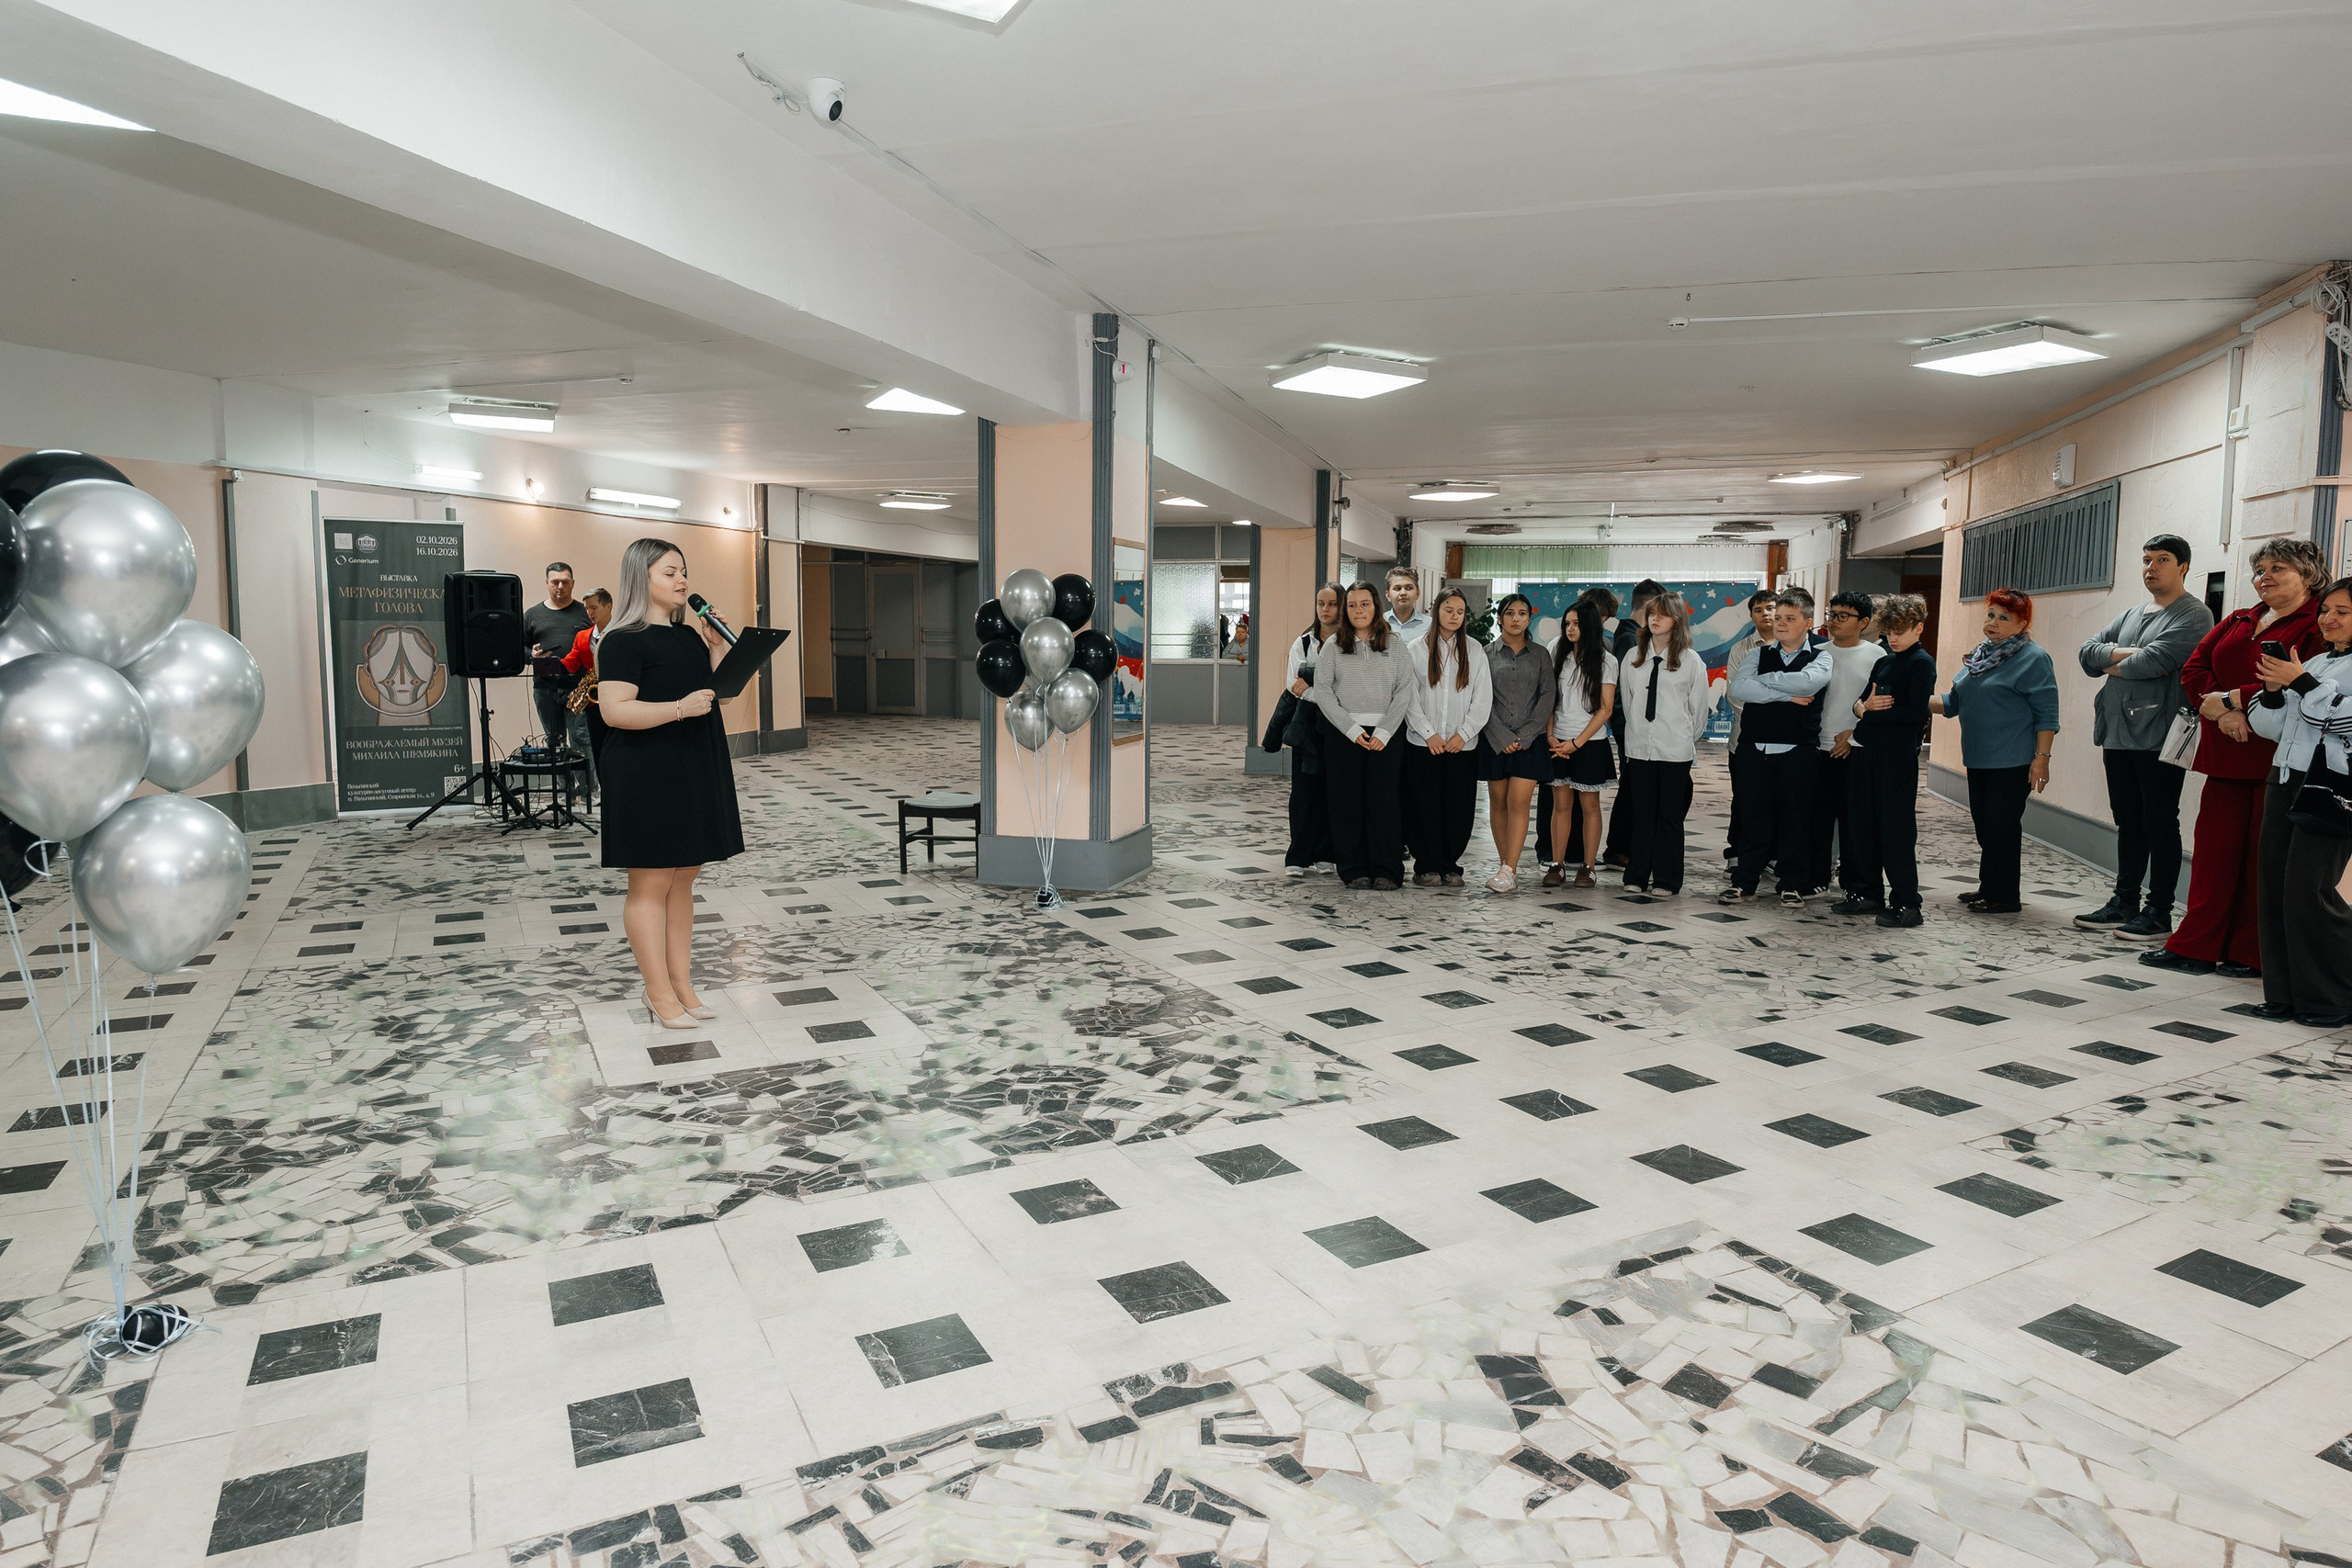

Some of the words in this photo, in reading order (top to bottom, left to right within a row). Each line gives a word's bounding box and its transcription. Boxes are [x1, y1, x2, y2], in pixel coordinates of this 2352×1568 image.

[416, 536, 458, 546] 02.10.2026
[416, 547, 458, 557] 16.10.2026
[338, 586, 445, 599] МЕТАФИЗИЧЕСКА
[375, 602, 424, 614] ГОЛОВА
[345, 737, 429, 749] ВООБРАЖАЕМЫЙ
[432, 736, 463, 746] МУЗЕЙ
[352, 750, 401, 761] МИХАИЛА
[402, 749, 458, 759] ШЕМЯКИНА
[454, 763, 466, 773] 6+
